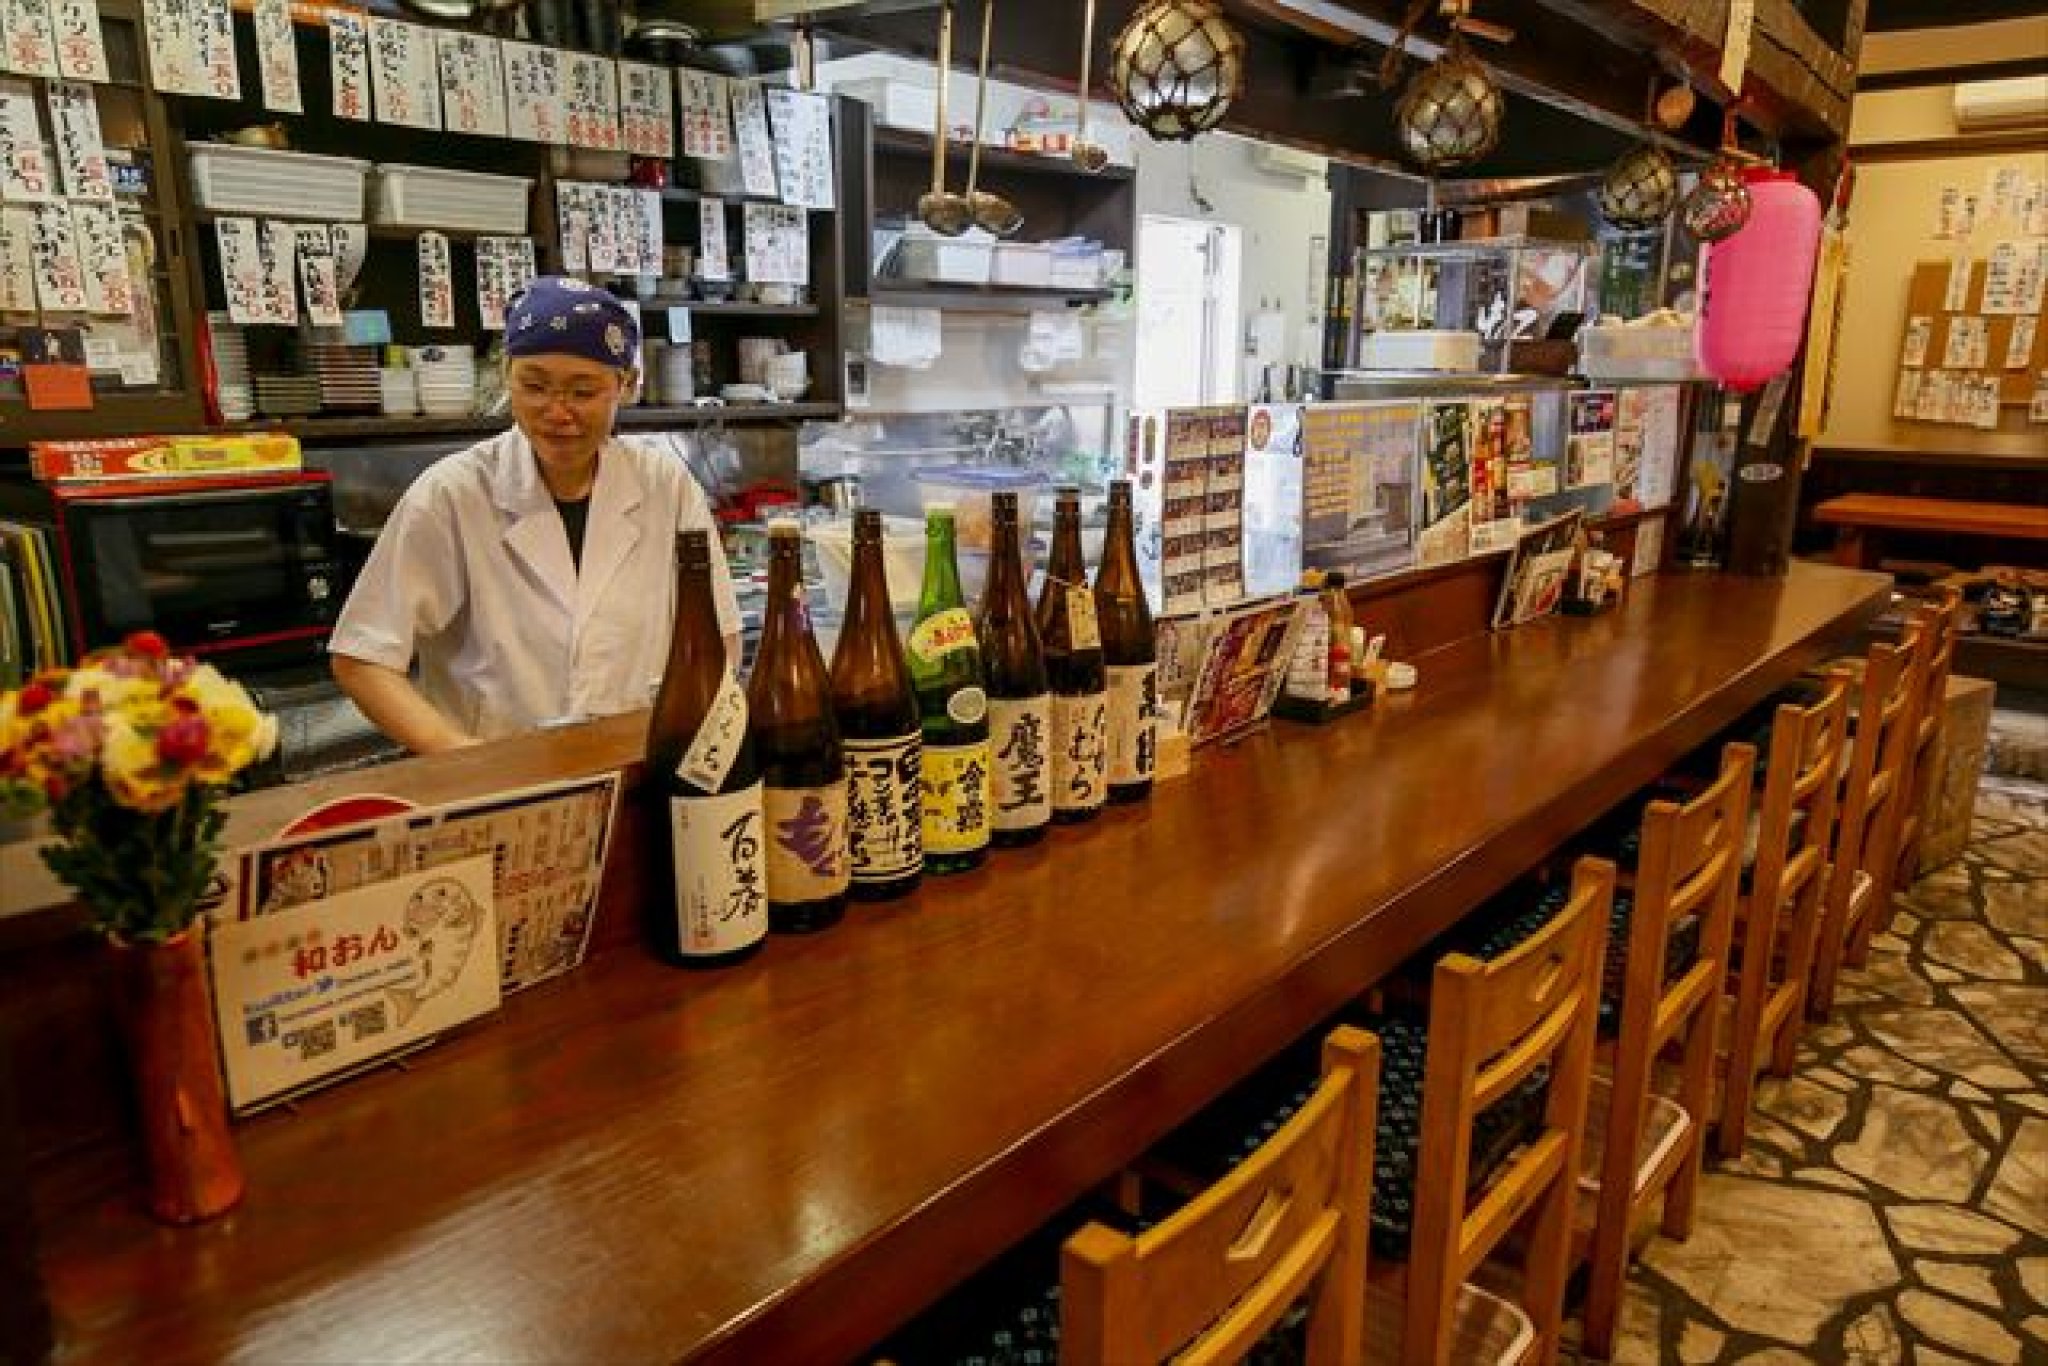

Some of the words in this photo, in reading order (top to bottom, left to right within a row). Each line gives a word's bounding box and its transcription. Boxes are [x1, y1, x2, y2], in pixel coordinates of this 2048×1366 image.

[998, 712, 1044, 811] 魔王
[293, 925, 399, 978] 和おん
